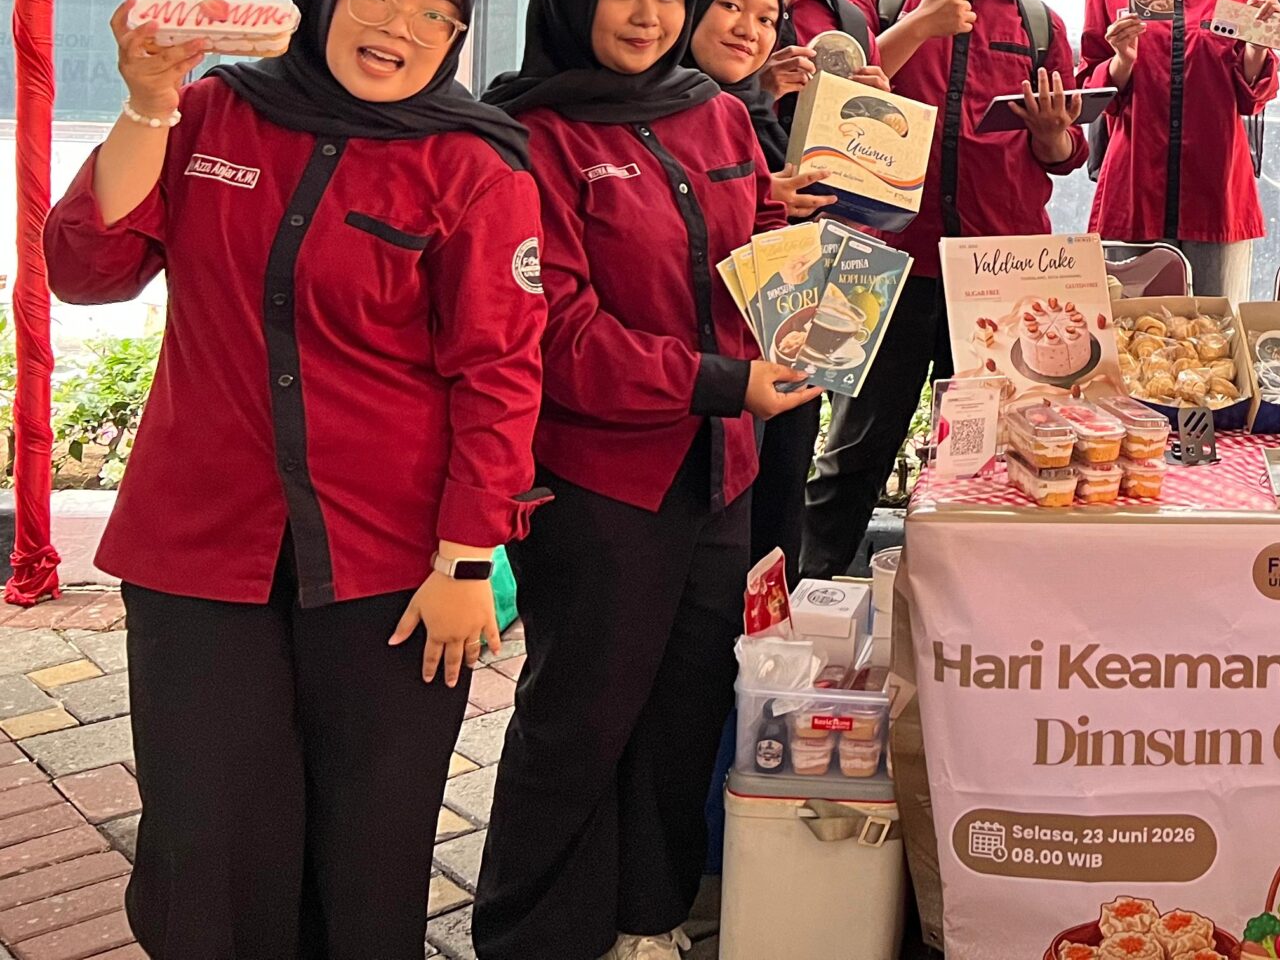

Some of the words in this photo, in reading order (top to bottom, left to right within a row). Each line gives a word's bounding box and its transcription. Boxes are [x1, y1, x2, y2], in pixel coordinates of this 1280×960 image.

[846, 137, 896, 167] Unimus
[973, 248, 1034, 276] Valdian
[1038, 247, 1076, 273] Cake
[776, 286, 819, 314] GORI
[932, 639, 1044, 689] Hari
[1032, 715, 1264, 767] Dimsum
[1012, 824, 1079, 844] Selasa,
[1082, 829, 1104, 844] 23
[1107, 827, 1148, 843] Juni
[1151, 827, 1195, 843] 2026
[1011, 847, 1063, 865] 08.00
[1067, 851, 1103, 868] WIB
